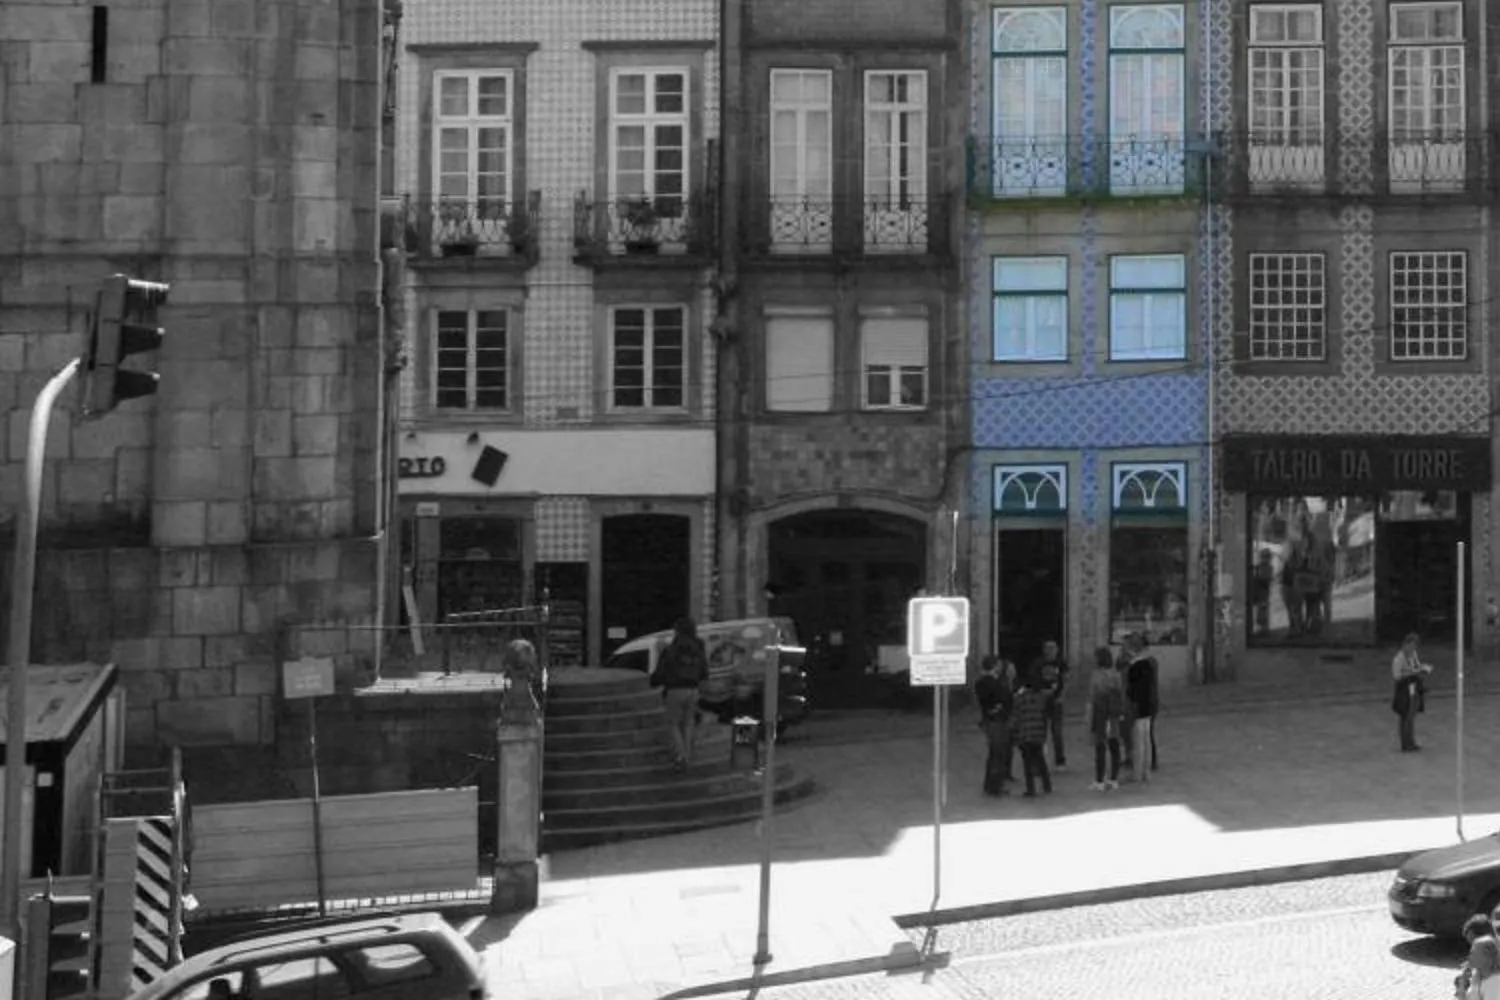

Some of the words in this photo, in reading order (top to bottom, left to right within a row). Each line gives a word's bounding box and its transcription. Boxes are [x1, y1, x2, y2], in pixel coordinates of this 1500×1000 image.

[1250, 448, 1322, 480] TALHO
[1341, 448, 1372, 480] DA
[1390, 448, 1464, 480] TORRE
[921, 604, 958, 652] P
